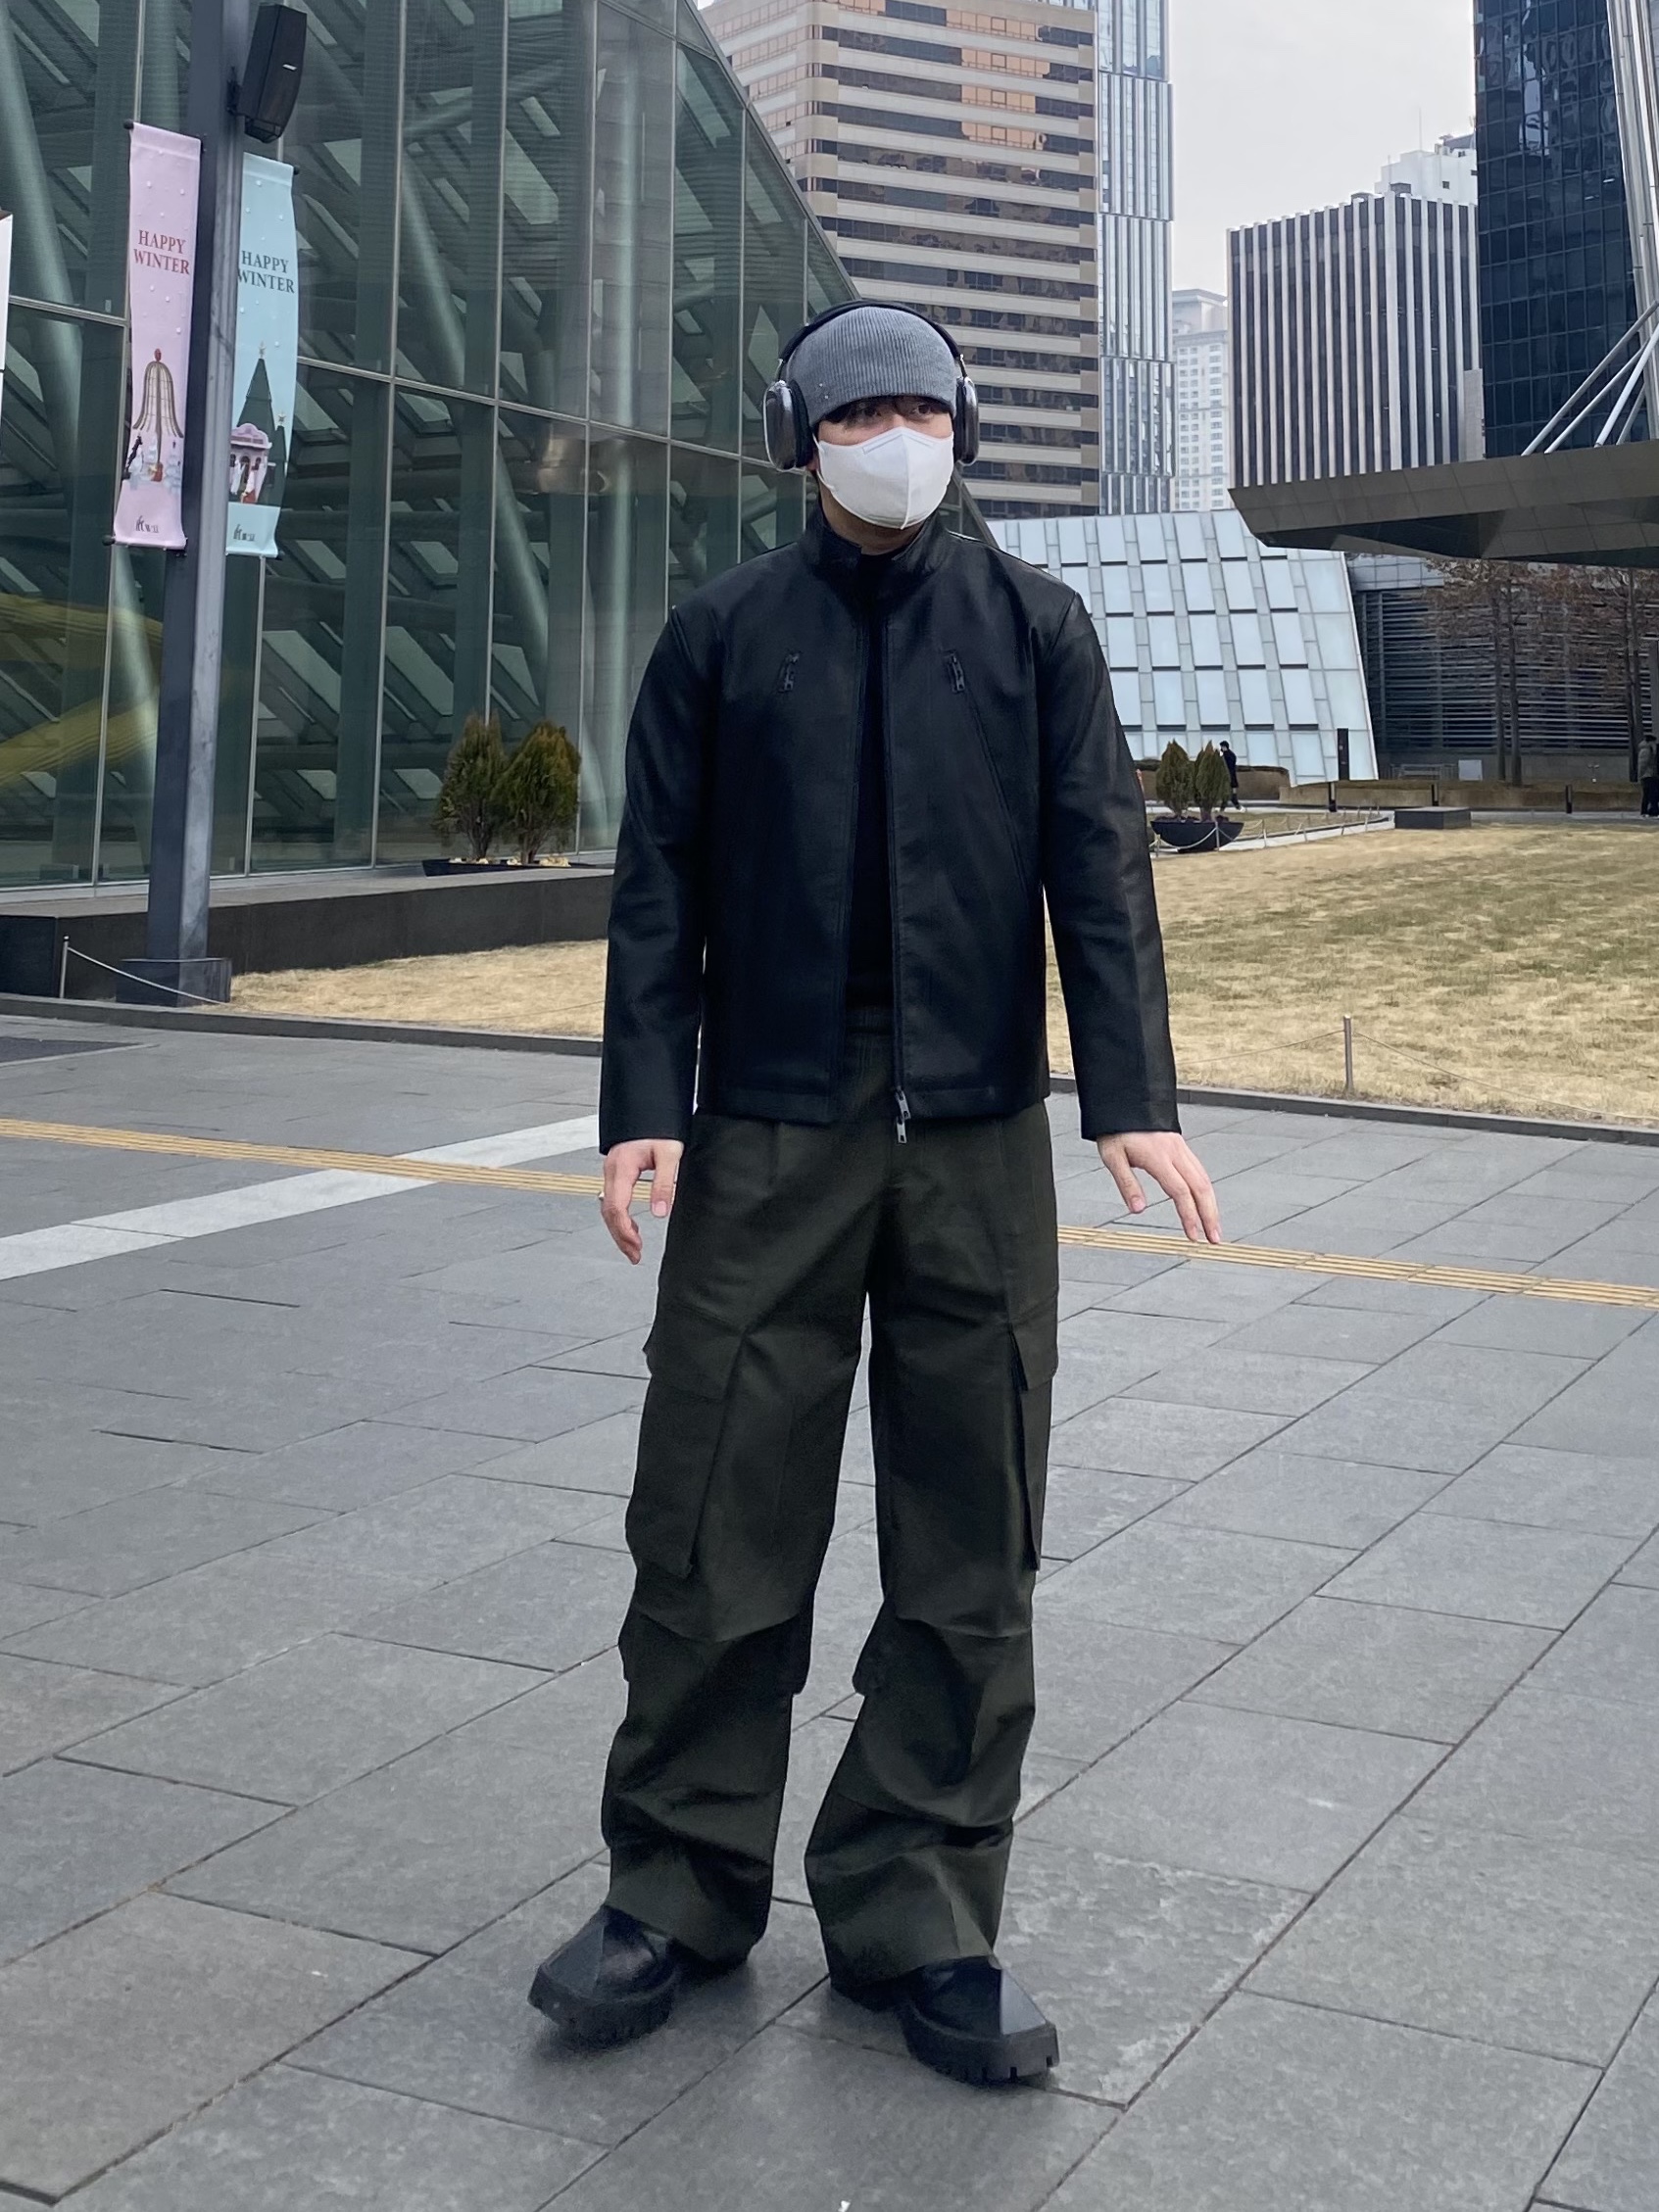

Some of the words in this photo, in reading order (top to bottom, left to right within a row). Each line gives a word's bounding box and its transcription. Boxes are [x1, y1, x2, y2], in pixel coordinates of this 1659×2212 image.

[138, 229, 187, 255] HAPPY
[133, 248, 190, 275] WINTER
[241, 250, 290, 274] HAPPY
